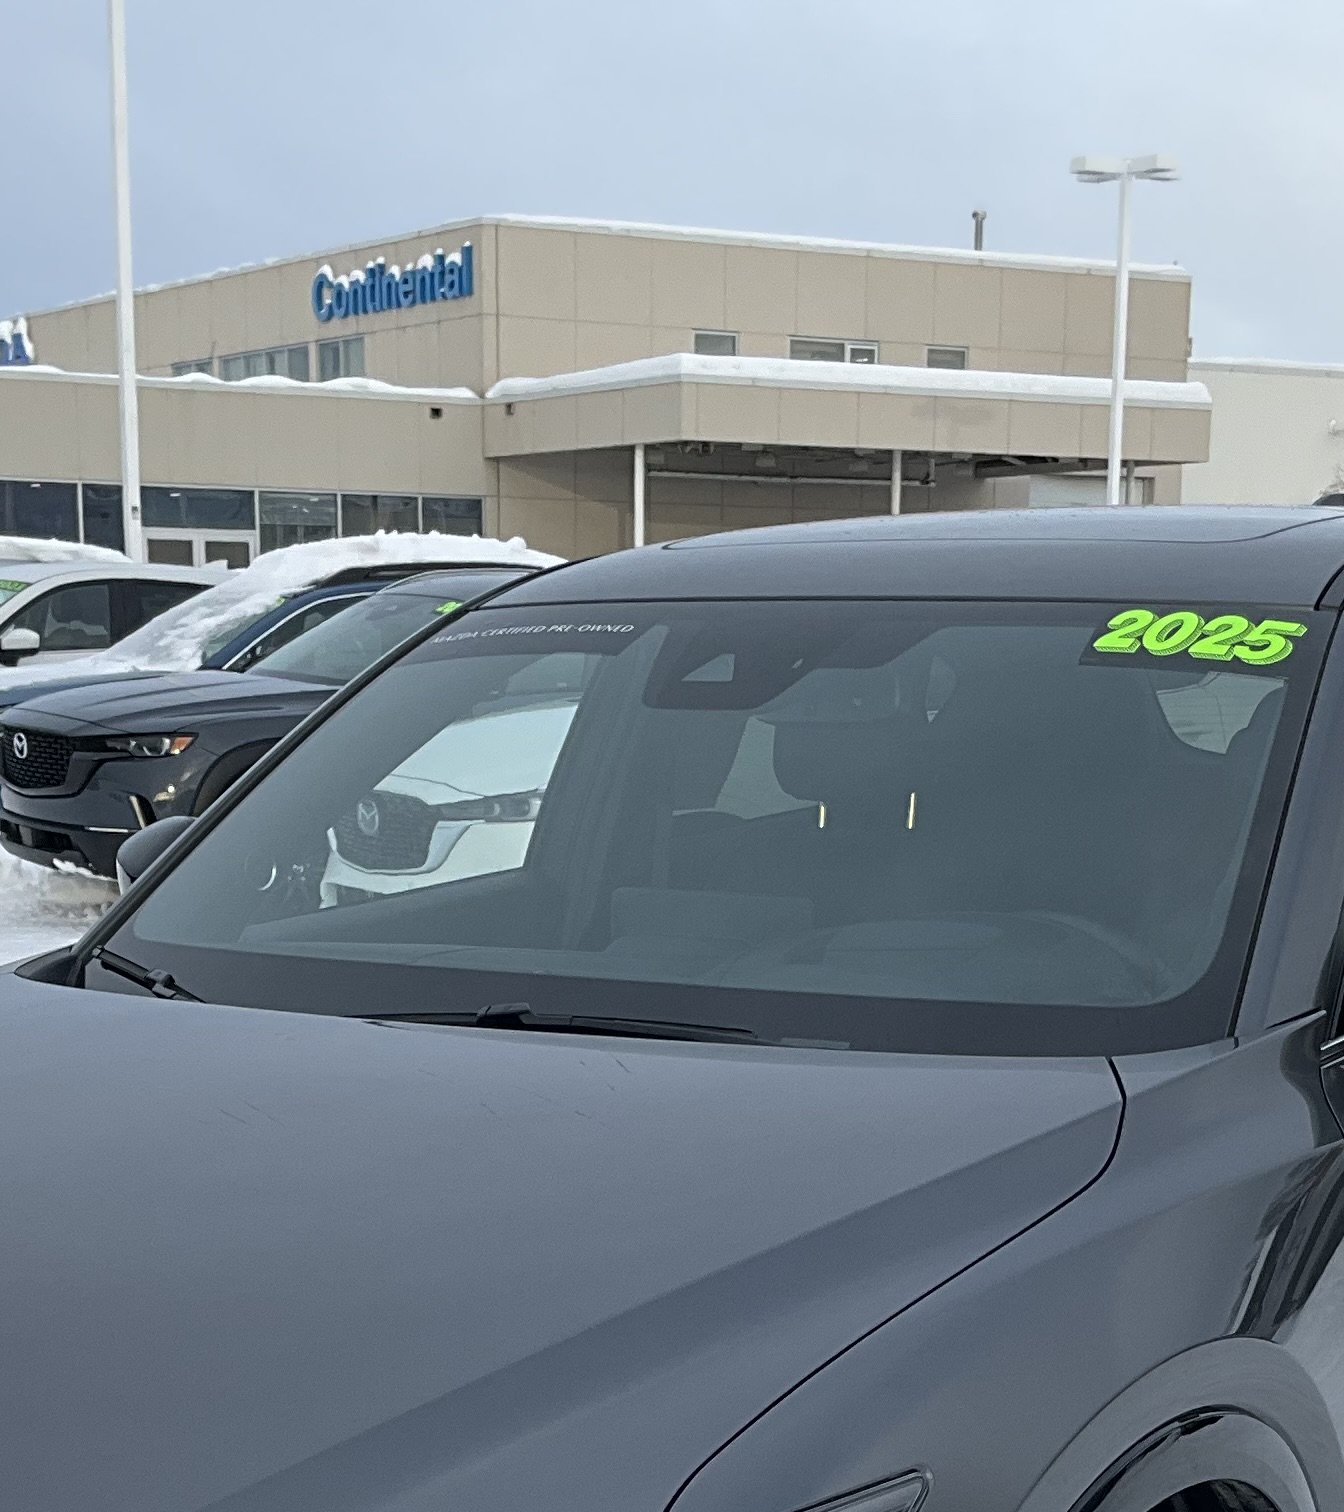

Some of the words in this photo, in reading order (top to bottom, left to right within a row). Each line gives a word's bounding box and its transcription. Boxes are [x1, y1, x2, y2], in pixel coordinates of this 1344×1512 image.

[311, 244, 474, 322] Continental
[481, 624, 546, 638] CERTIFIED
[546, 623, 635, 634] PRE-OWNED
[1092, 609, 1308, 666] 2025
